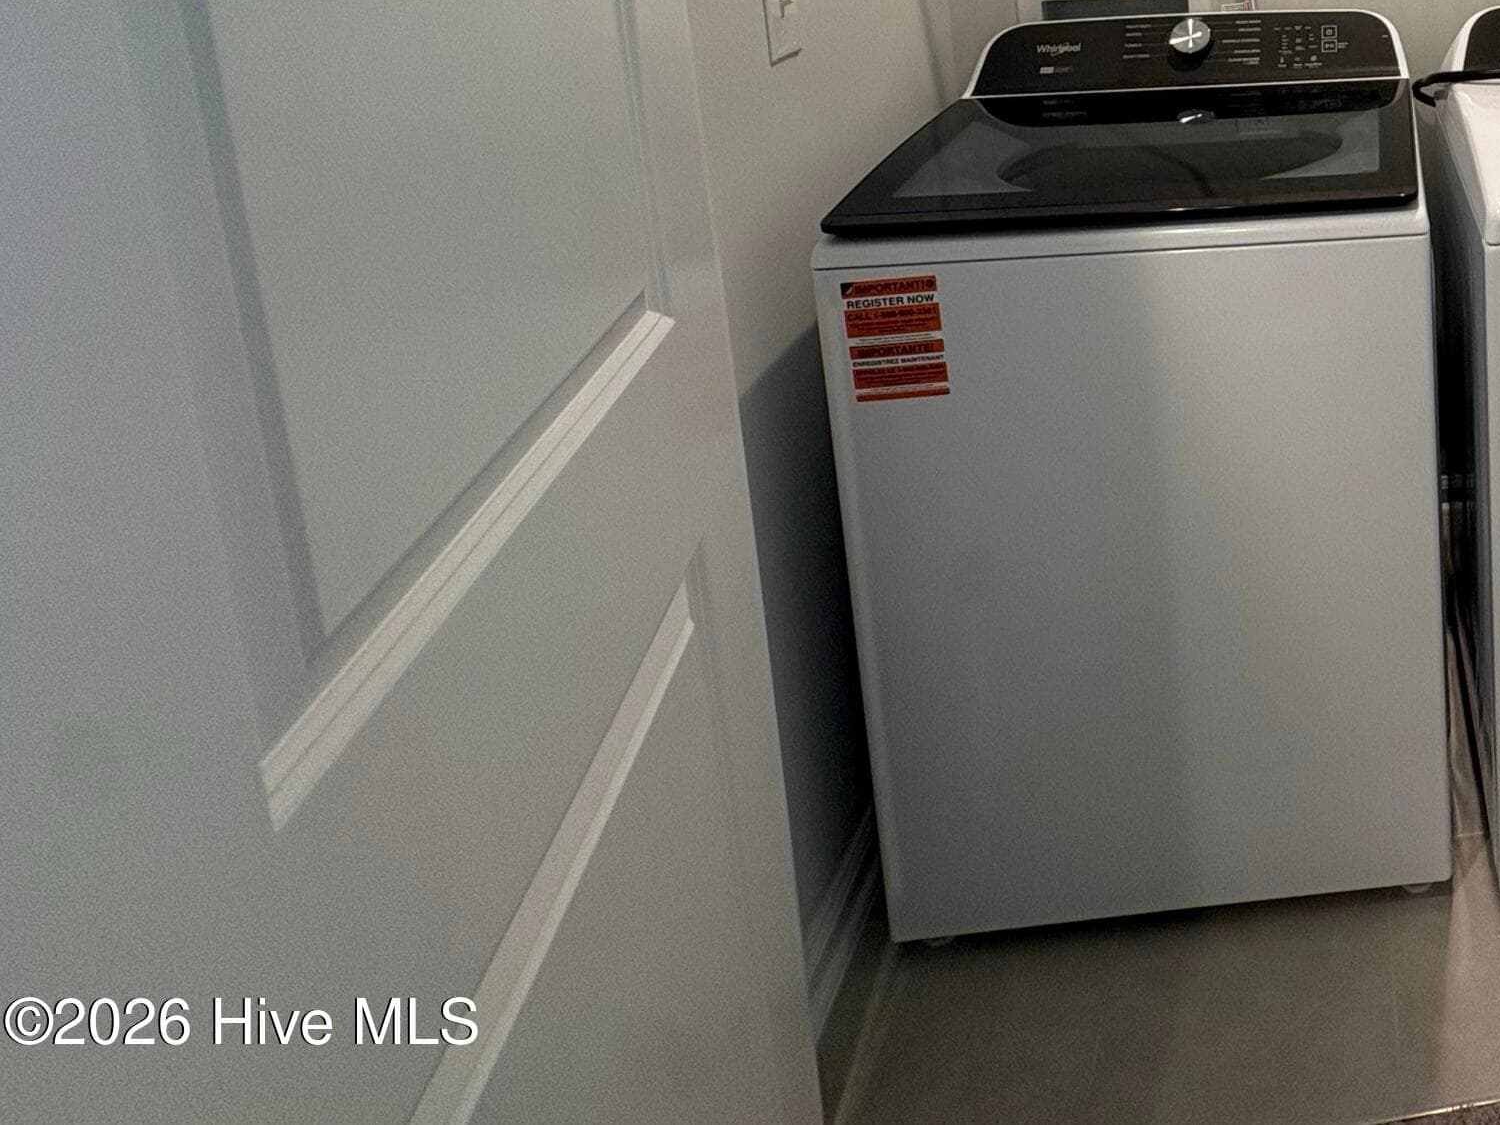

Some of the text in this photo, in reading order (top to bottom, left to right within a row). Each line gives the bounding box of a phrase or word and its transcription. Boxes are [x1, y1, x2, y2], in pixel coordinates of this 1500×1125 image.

[1037, 42, 1081, 55] Whirlpool
[847, 294, 935, 309] REGISTER NOW
[847, 312, 870, 322] CALL
